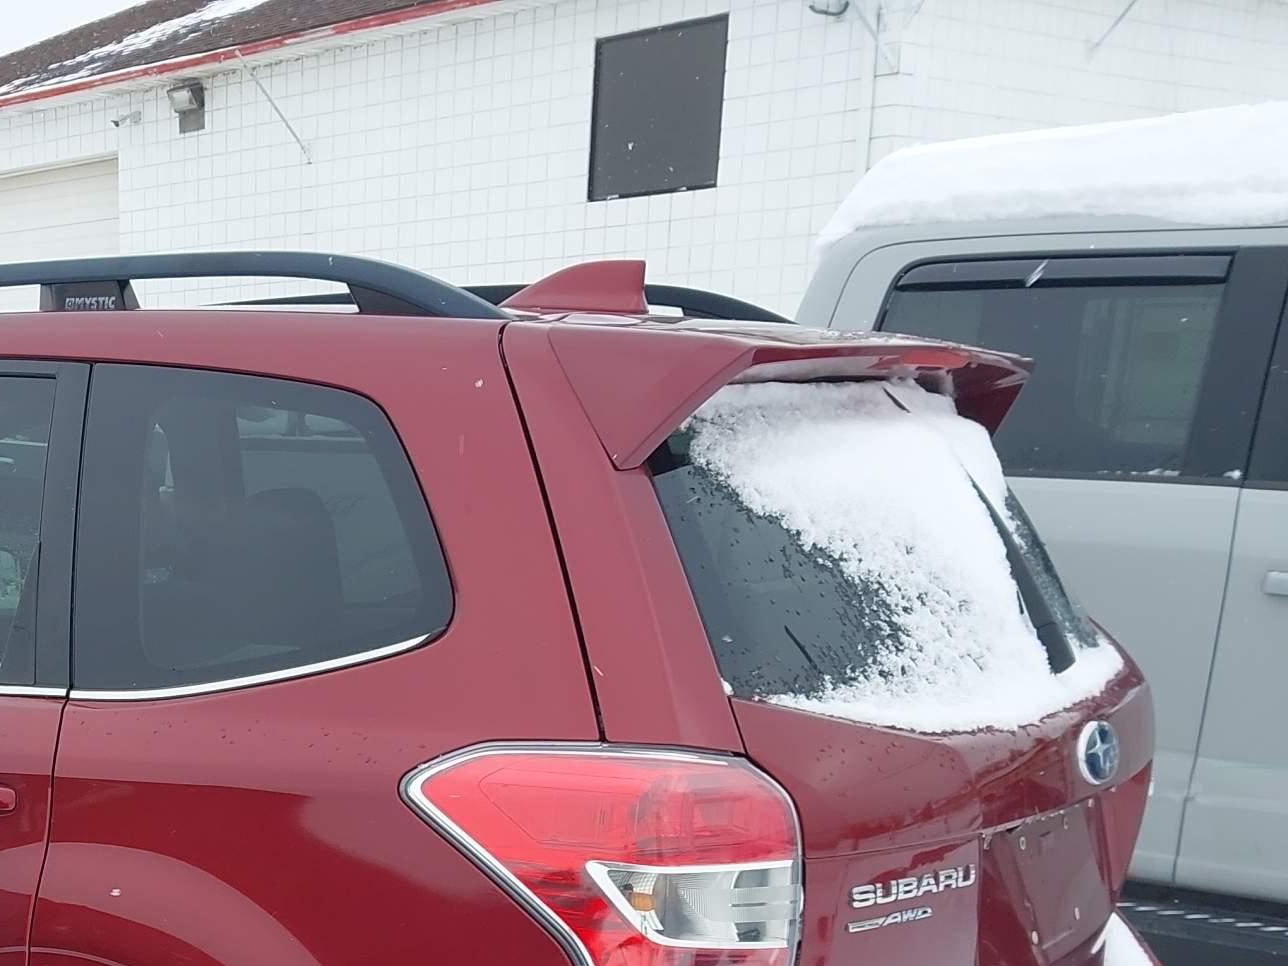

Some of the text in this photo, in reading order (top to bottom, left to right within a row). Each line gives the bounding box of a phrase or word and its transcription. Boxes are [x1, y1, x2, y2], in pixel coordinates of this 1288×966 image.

[75, 296, 116, 309] MYSTIC
[850, 864, 976, 909] SUBARU
[882, 906, 934, 927] AWD
